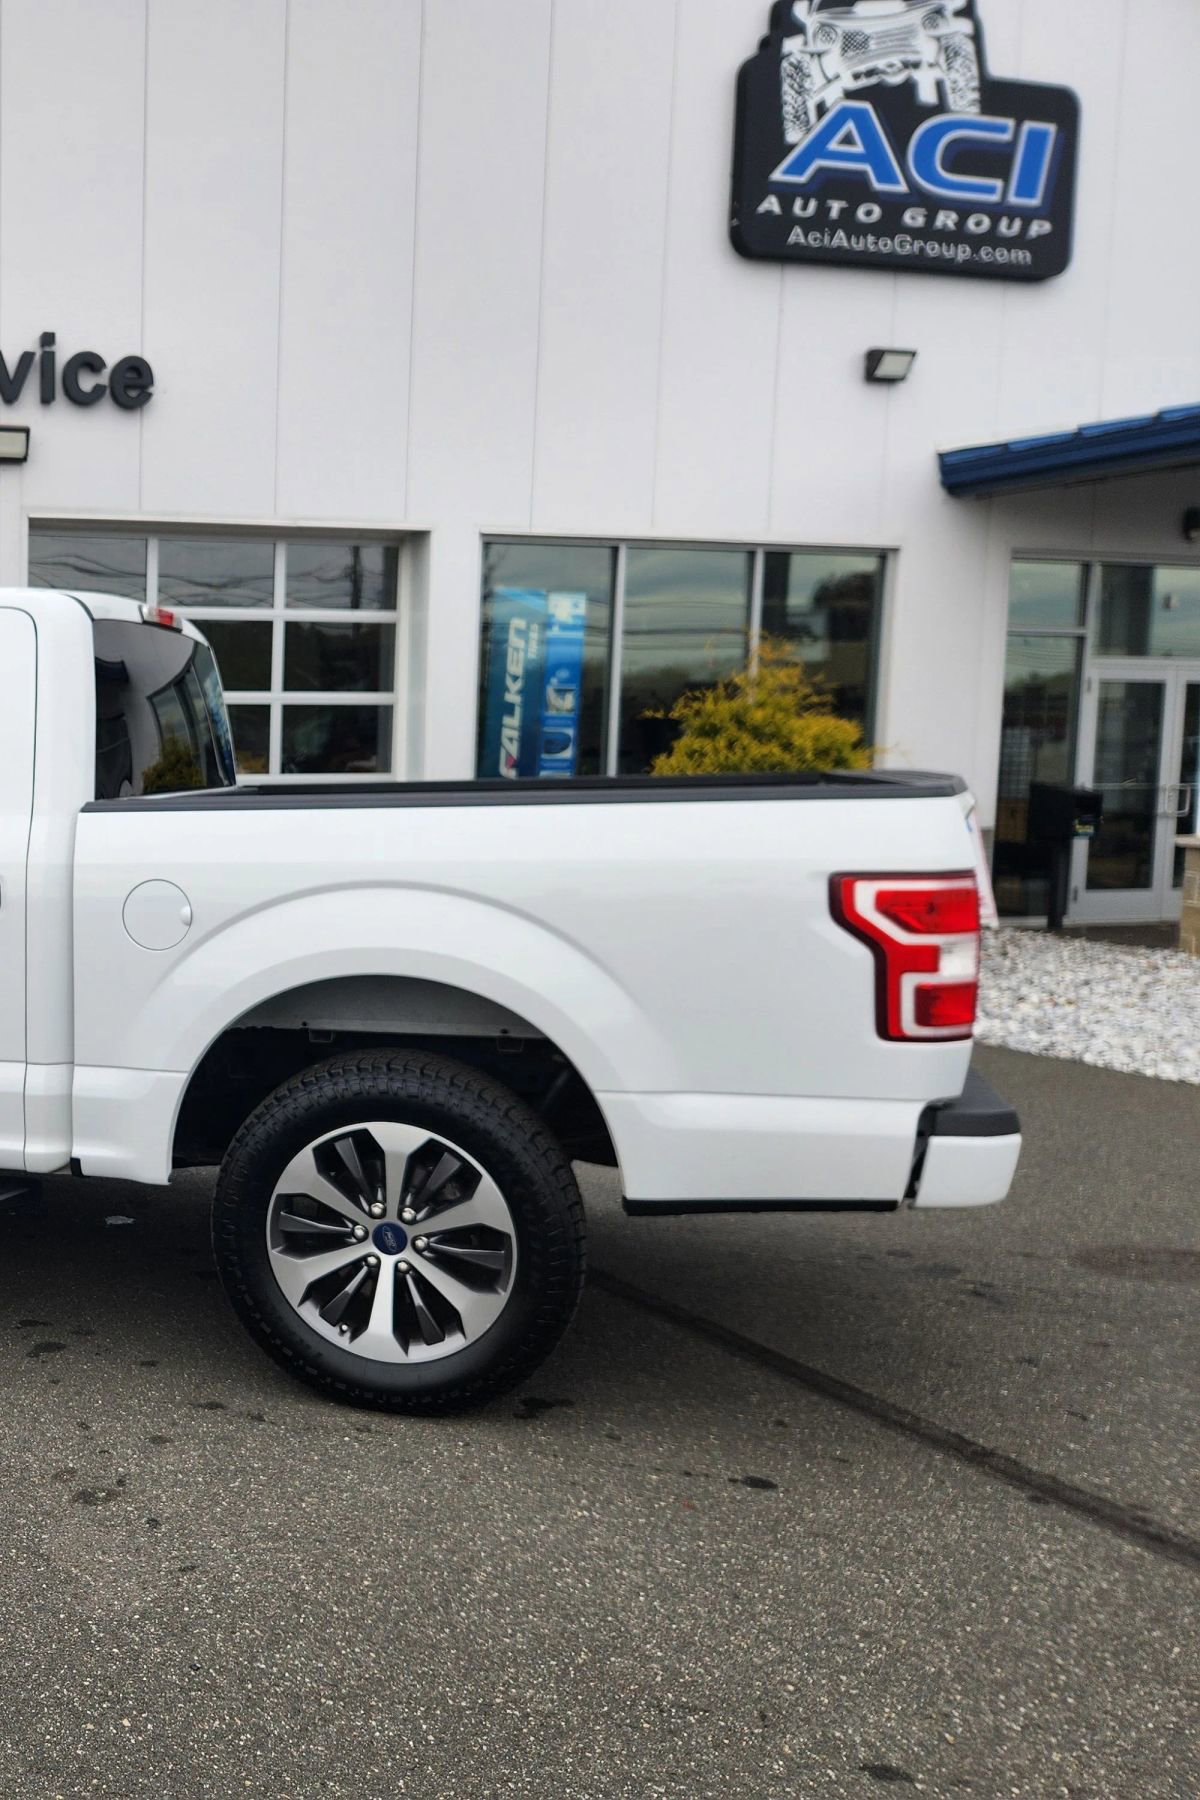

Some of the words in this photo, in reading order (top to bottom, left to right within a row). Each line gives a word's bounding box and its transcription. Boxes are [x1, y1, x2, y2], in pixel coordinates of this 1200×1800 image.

[769, 100, 1057, 207] ACI
[756, 194, 882, 223] AUTO
[901, 207, 1053, 240] GROUP
[786, 225, 1032, 265] AciAutoGroup.com
[499, 616, 528, 779] FALKEN
